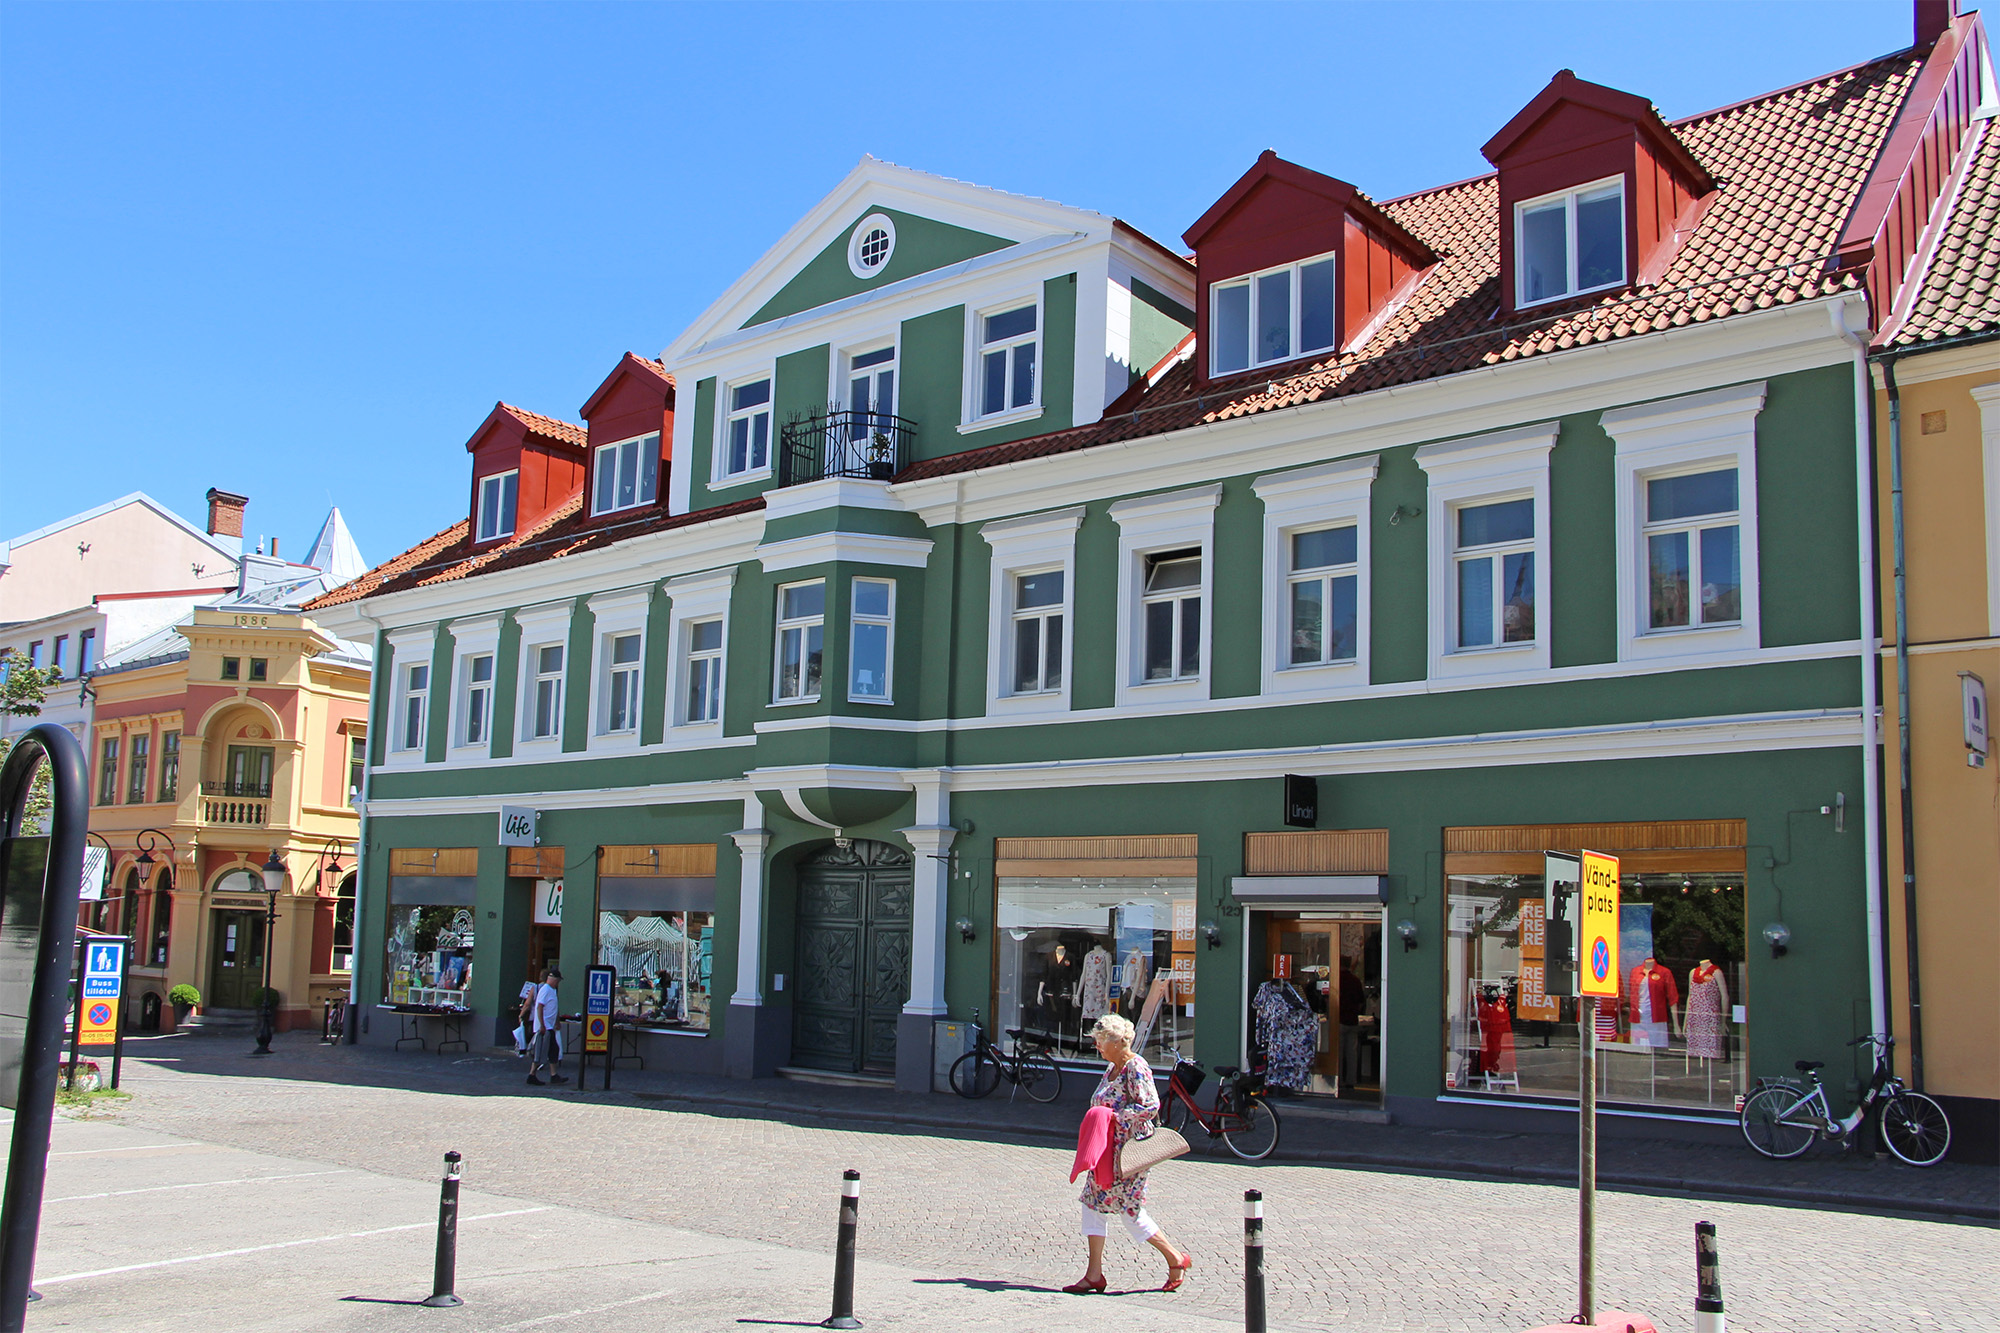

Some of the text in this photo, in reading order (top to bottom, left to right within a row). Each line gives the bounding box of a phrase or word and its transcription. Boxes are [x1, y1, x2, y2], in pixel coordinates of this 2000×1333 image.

[233, 615, 268, 626] 1886
[505, 814, 531, 838] life
[1585, 863, 1617, 888] Vänd-
[547, 883, 563, 917] li
[1588, 891, 1613, 915] plats
[1523, 905, 1544, 918] RE
[1523, 919, 1545, 932] RE
[1523, 932, 1544, 945] RE
[1523, 966, 1543, 980] RE
[91, 979, 113, 987] Buss
[1522, 980, 1543, 993] RE
[1522, 993, 1555, 1008] REA
